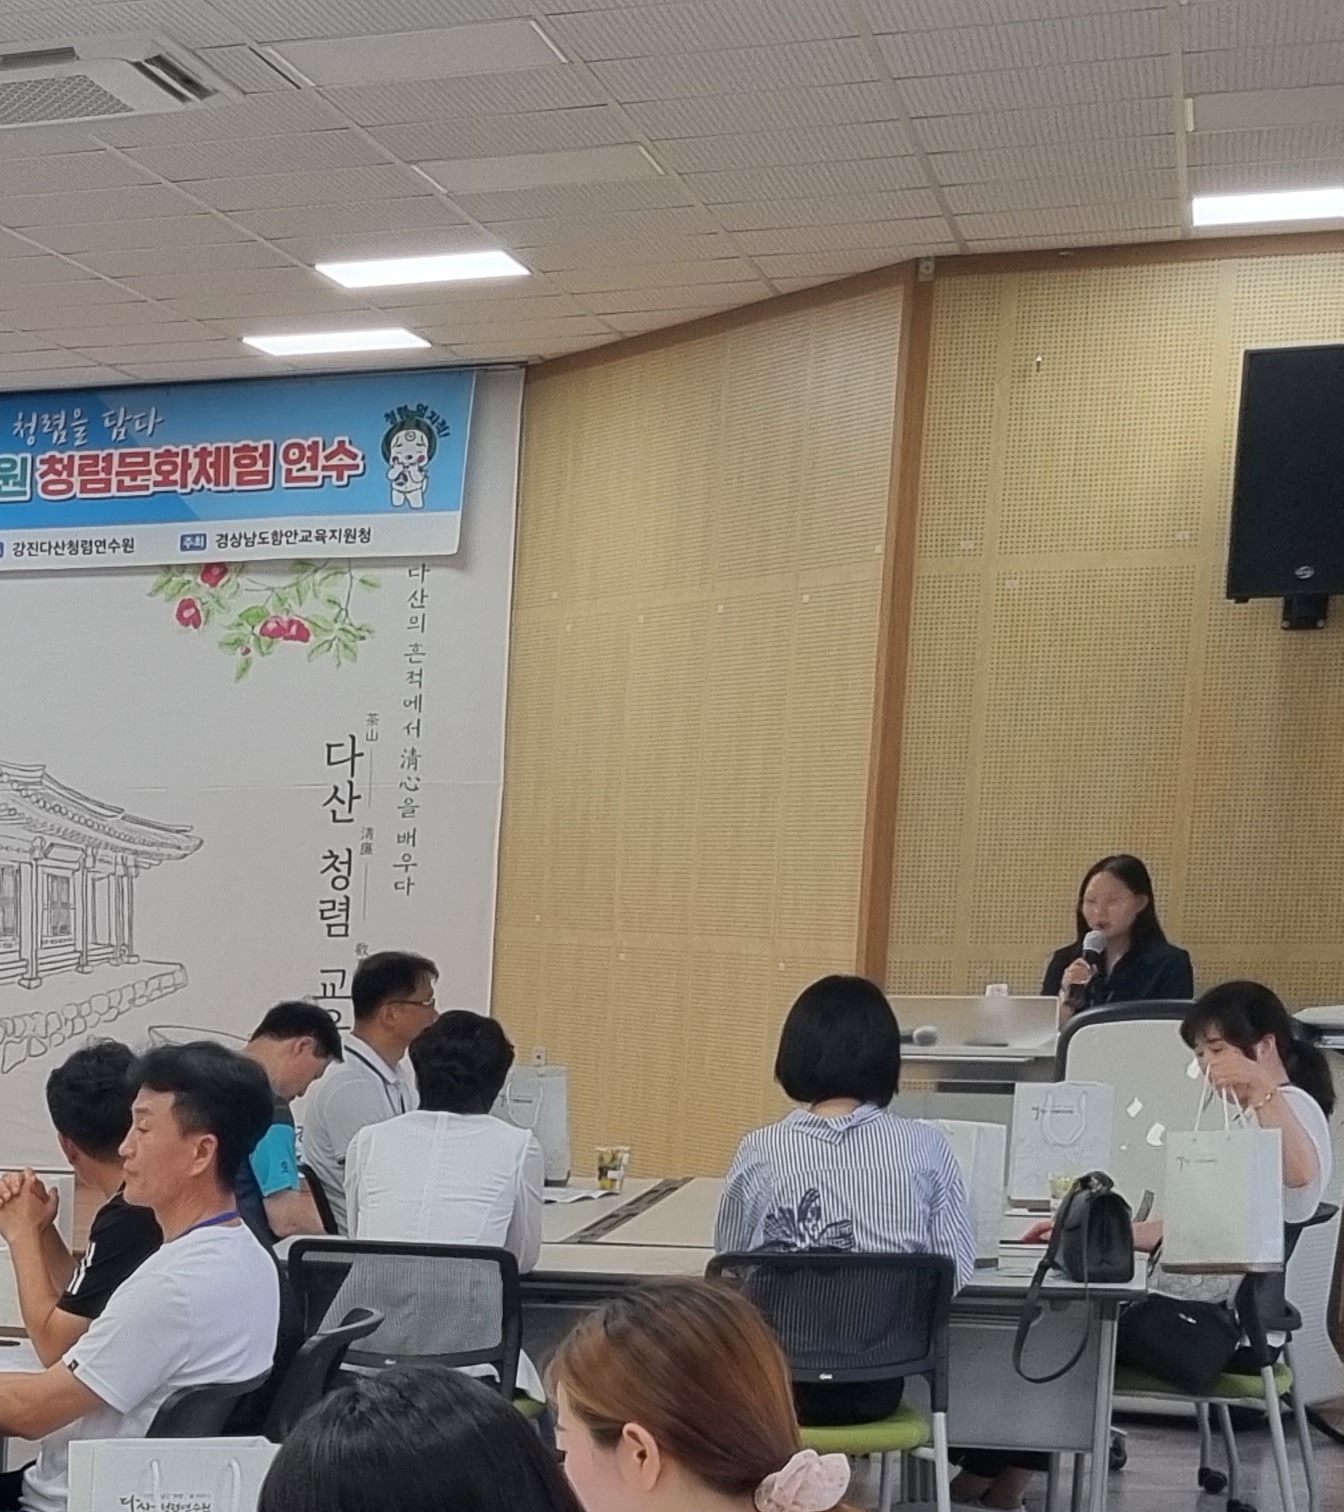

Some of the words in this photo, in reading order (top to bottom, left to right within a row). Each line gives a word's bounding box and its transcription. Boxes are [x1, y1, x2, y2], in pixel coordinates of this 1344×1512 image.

[12, 408, 90, 446] 청렴을
[102, 405, 165, 442] 담다
[35, 440, 274, 499] 청렴문화체험
[280, 437, 365, 487] 연수
[12, 536, 136, 558] 강진다산청렴연수원
[215, 527, 372, 549] 경상남도함안교육지원청
[407, 563, 431, 634] 다산의
[403, 642, 427, 739] 흔적에서
[324, 733, 364, 824] 다산
[317, 847, 354, 939] 청렴
[393, 829, 418, 896] 배우다
